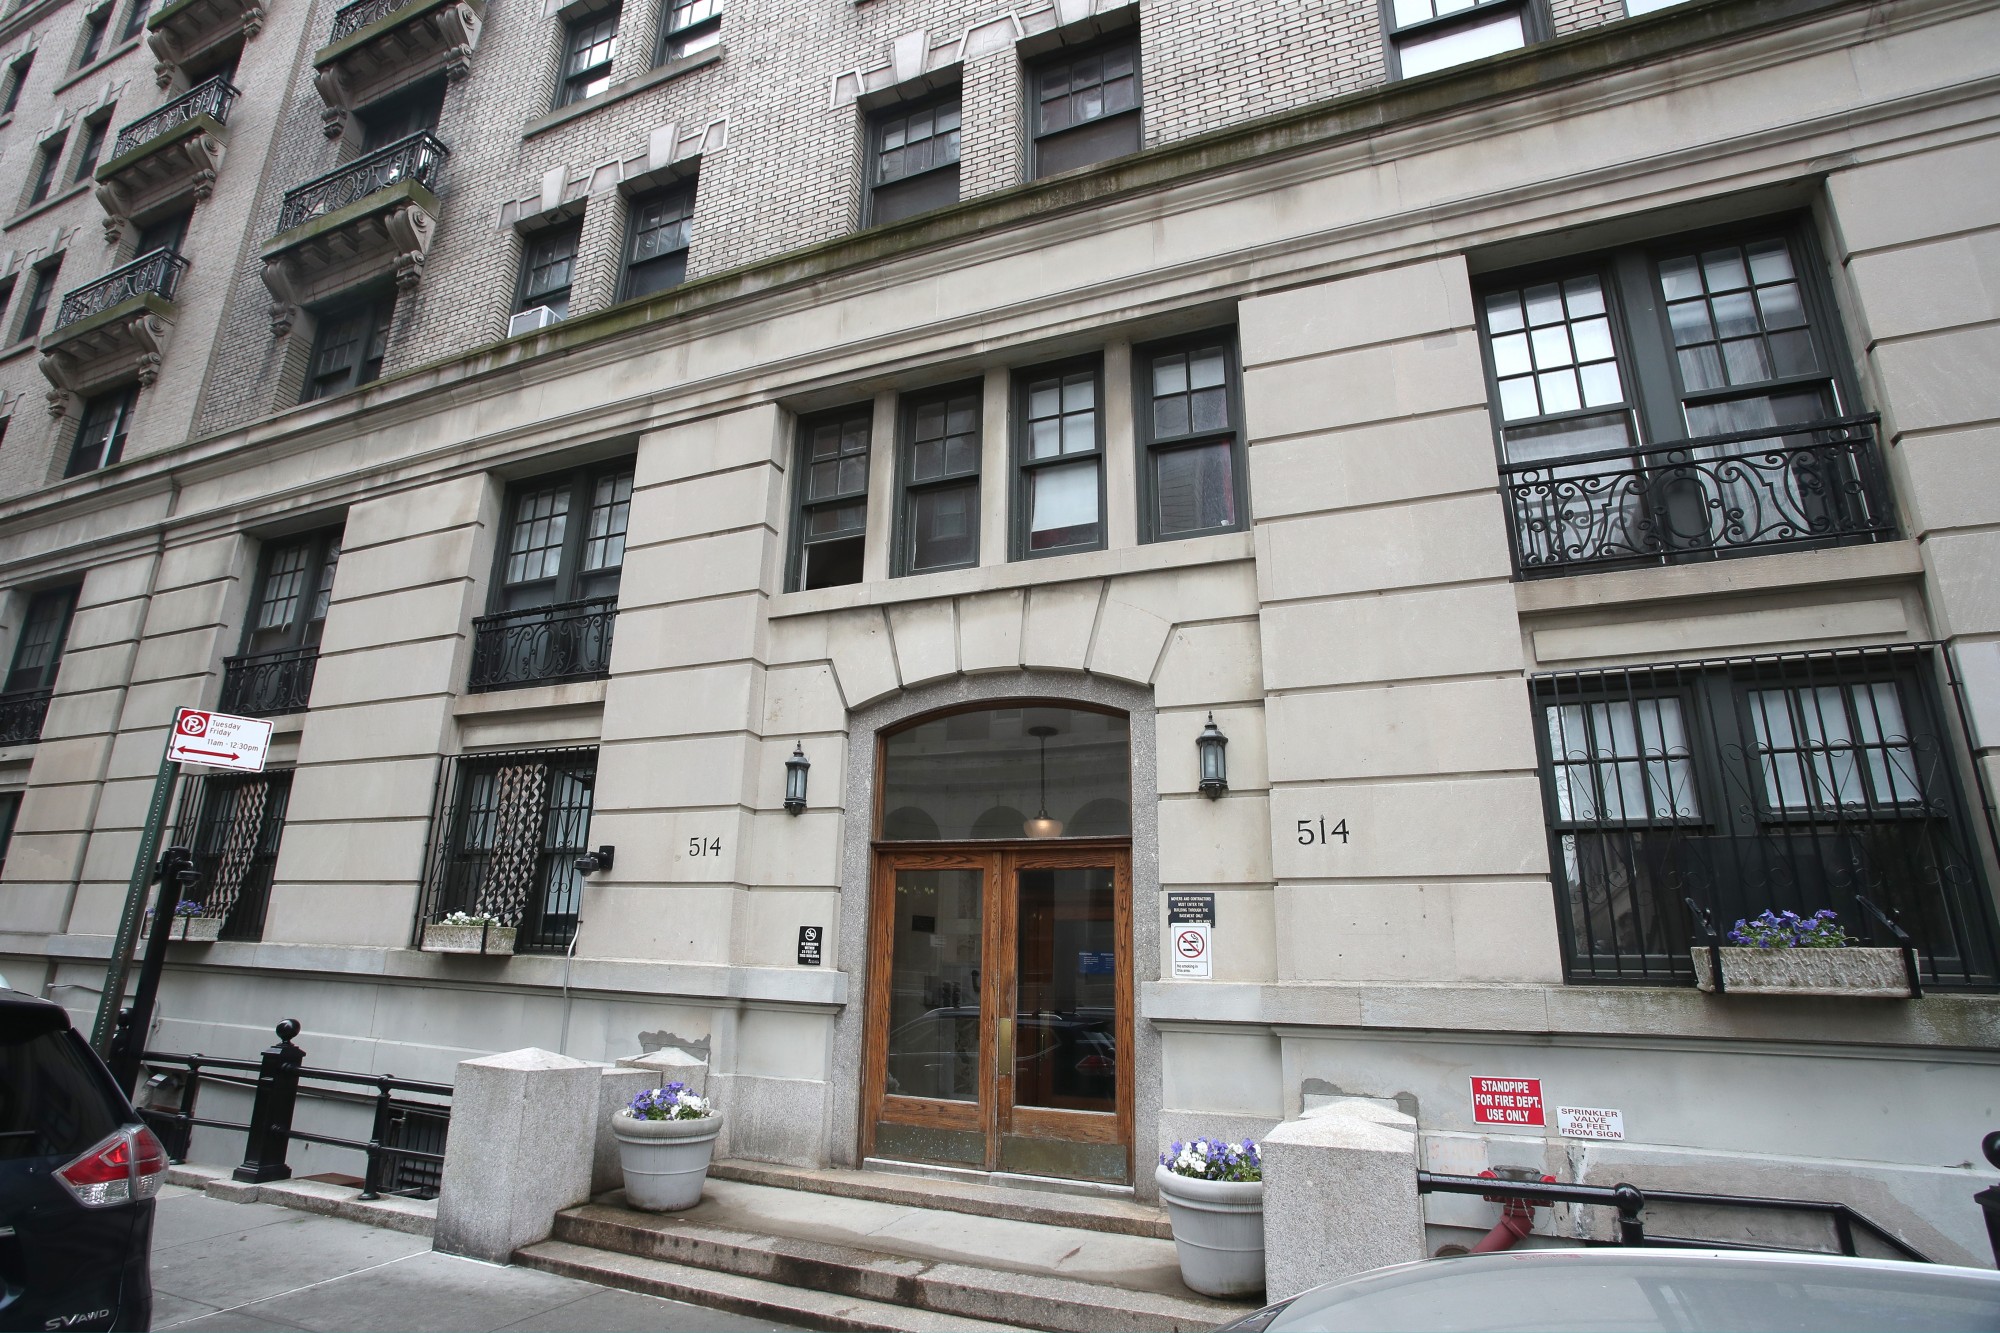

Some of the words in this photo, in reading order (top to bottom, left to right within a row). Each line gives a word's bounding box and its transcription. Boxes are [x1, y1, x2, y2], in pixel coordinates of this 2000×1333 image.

[209, 727, 232, 737] Friday
[212, 719, 241, 731] Tuesday
[207, 738, 224, 747] 11am
[230, 741, 259, 752] 12:30pm
[1297, 817, 1349, 845] 514
[689, 837, 721, 856] 514
[1481, 1080, 1529, 1094] STANDPIPE
[1475, 1094, 1493, 1106] FOR
[1494, 1094, 1515, 1107] FIRE
[1516, 1095, 1541, 1109] DEPT.
[1486, 1108, 1504, 1121] USE
[1505, 1109, 1529, 1122] ONLY
[1561, 1108, 1618, 1118] SPRINKLER
[1574, 1116, 1607, 1124] VALVE
[1561, 1128, 1593, 1137] FROM
[1596, 1129, 1622, 1138] SIGN
[1586, 1123, 1611, 1131] FEET
[45, 1313, 80, 1331] SV
[76, 1309, 110, 1324] AWD
